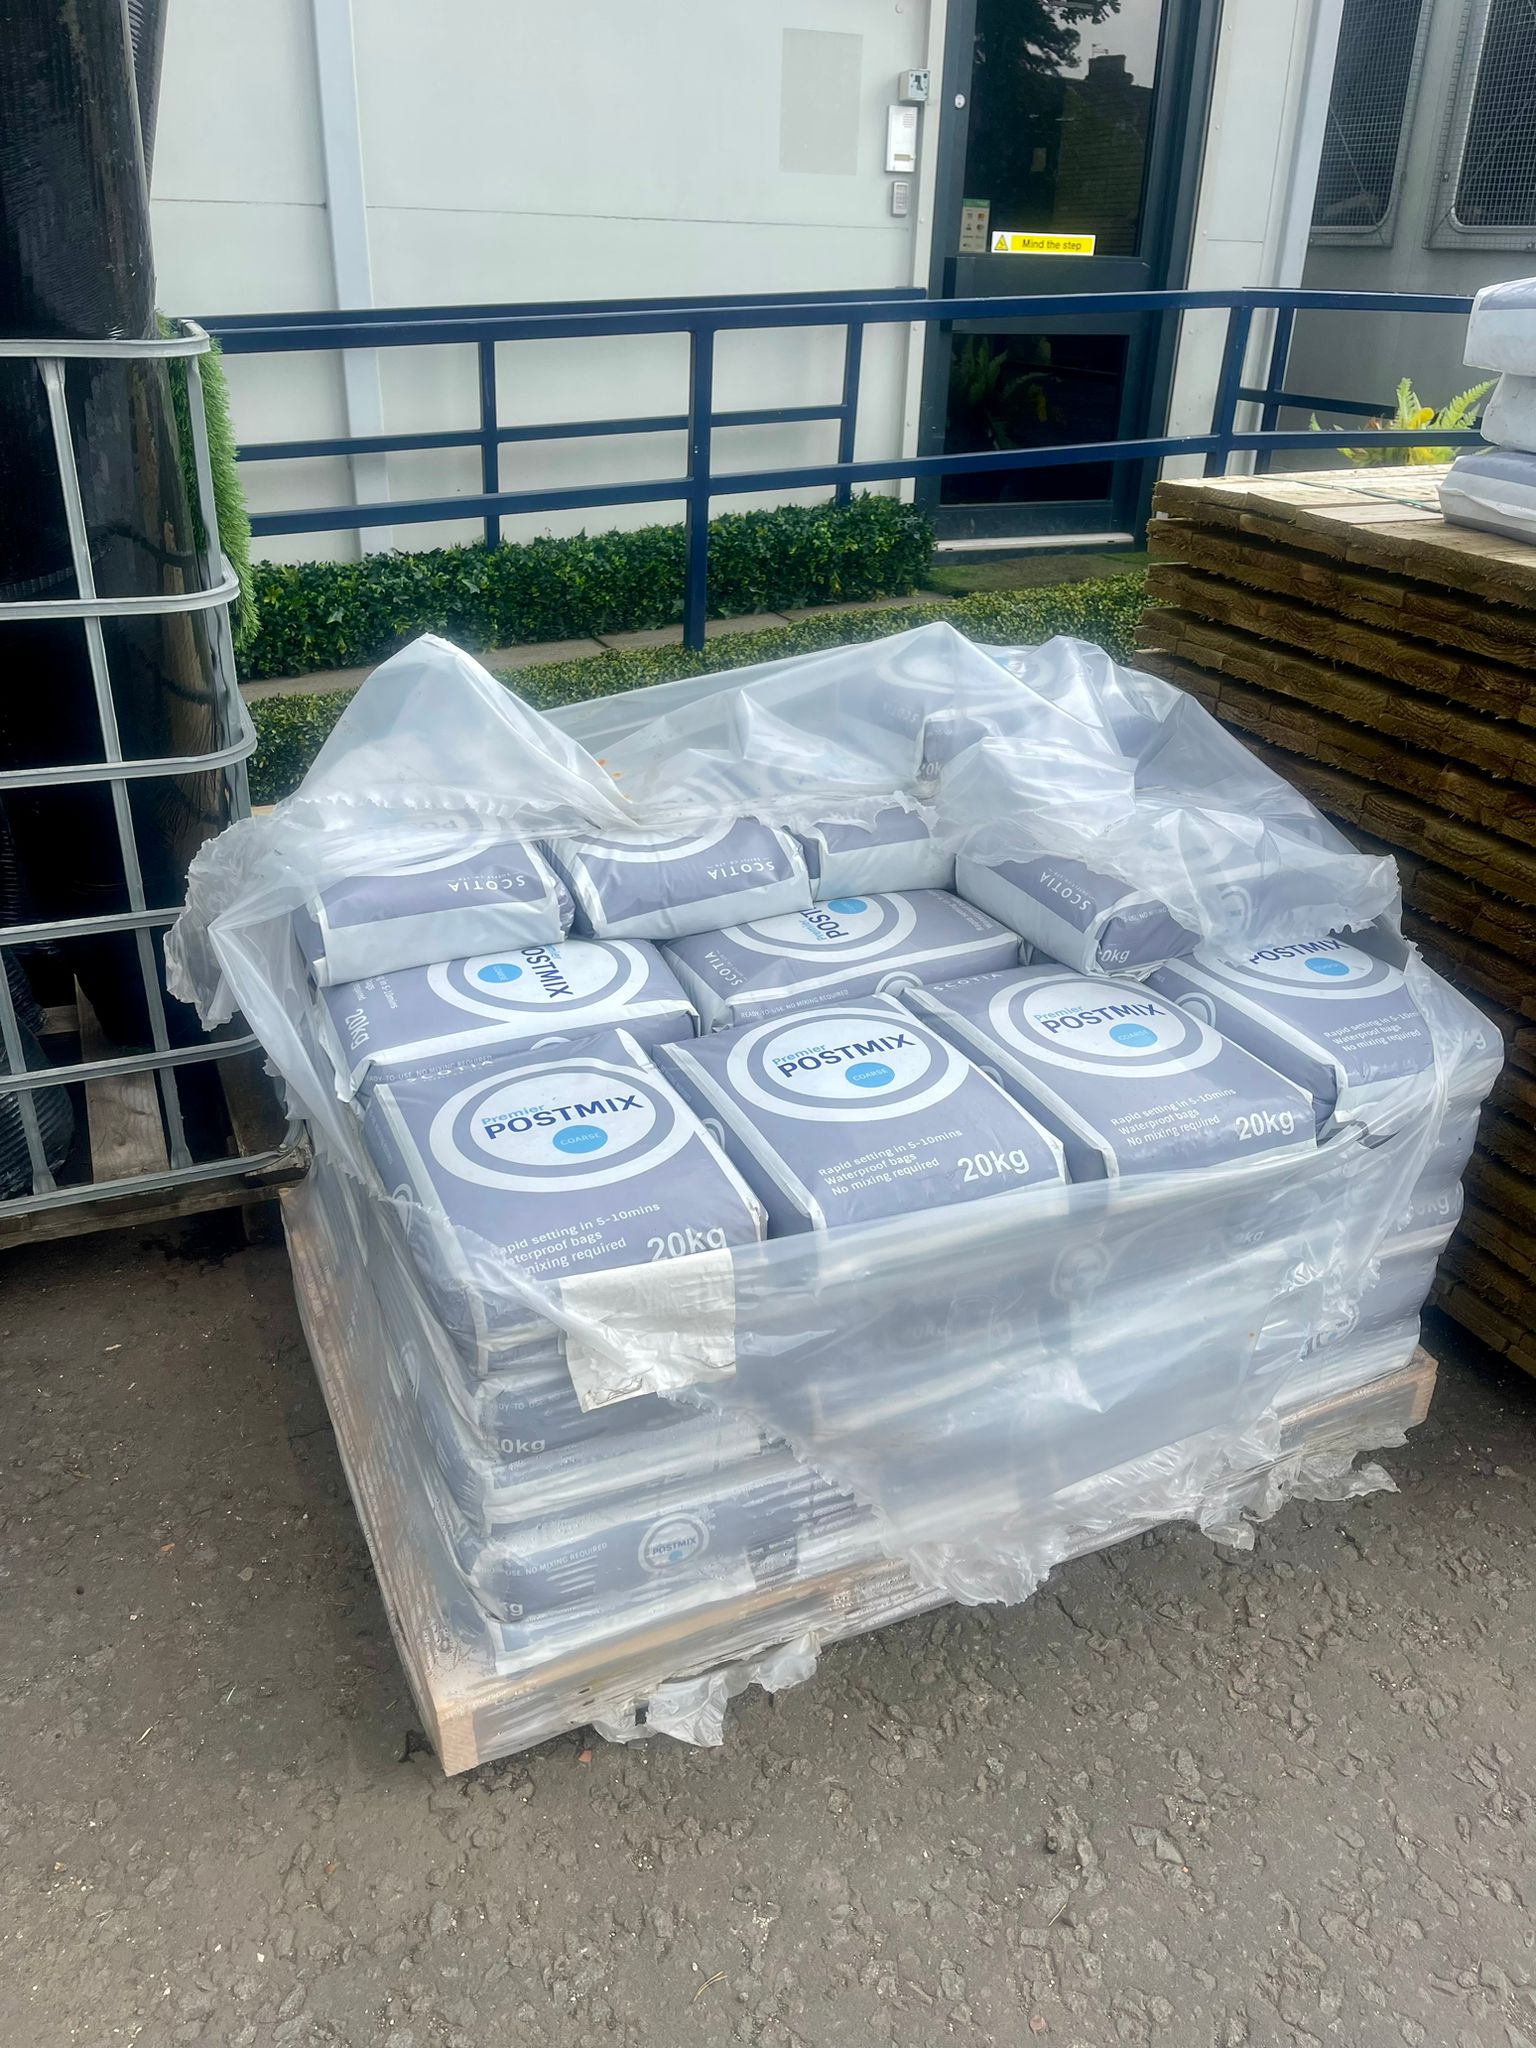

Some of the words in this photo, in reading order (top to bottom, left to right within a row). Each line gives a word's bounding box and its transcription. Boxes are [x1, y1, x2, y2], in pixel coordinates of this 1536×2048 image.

[1021, 239, 1045, 249] Mind
[1047, 239, 1060, 249] the
[1063, 240, 1082, 251] step
[448, 875, 526, 892] SCOTIA
[707, 861, 775, 880] SCOTIA
[1040, 871, 1091, 911] SCOTIA
[800, 907, 849, 940] POST
[704, 951, 744, 986] SCOTIA
[1099, 949, 1131, 963] 0kg
[520, 946, 574, 999] OSTMIX
[933, 972, 1003, 992] SCOTIA
[1034, 1005, 1085, 1022] Premier
[1040, 1003, 1166, 1034] POSTMIX
[1323, 1027, 1351, 1039] Rapid
[1350, 1019, 1383, 1032] setting
[1380, 1014, 1391, 1024] in
[345, 1008, 370, 1051] 20kg
[1332, 1029, 1383, 1045] Waterproof
[1381, 1024, 1402, 1034] bags
[1342, 1043, 1357, 1052] No
[1357, 1037, 1388, 1049] mixing
[1387, 1029, 1422, 1043] required
[772, 1044, 827, 1066] Premier
[777, 1033, 916, 1079] POSTMIX
[481, 1104, 545, 1125] Premier
[484, 1094, 644, 1140] POSTMIX
[1110, 1111, 1141, 1127] Rapid
[1143, 1102, 1177, 1118] setting
[1176, 1099, 1188, 1109] in
[1188, 1088, 1237, 1106] 5-10mins
[1118, 1115, 1175, 1136] Waterproof
[1175, 1109, 1200, 1121] bags
[560, 1132, 600, 1146] COARSE
[1127, 1137, 1142, 1148] No
[1143, 1124, 1180, 1144] mixing
[1180, 1114, 1221, 1133] required
[1235, 1110, 1295, 1141] 20kg
[818, 1160, 852, 1177] Rapid
[854, 1147, 895, 1166] setting
[894, 1144, 907, 1153] in
[907, 1128, 964, 1150] 5-10mins
[957, 1149, 1030, 1183] 20kg
[824, 1160, 888, 1185] Waterproof
[889, 1152, 918, 1166] bags
[831, 1185, 849, 1197] No
[851, 1170, 892, 1190] mixing
[892, 1157, 940, 1178] required
[531, 1224, 577, 1246] setting
[579, 1220, 594, 1232] in
[596, 1203, 661, 1227] 5-10mins
[570, 1231, 603, 1249] bags
[571, 1237, 627, 1262] required
[647, 1225, 728, 1263] 20kg
[498, 1438, 546, 1455] 0kg
[525, 1566, 537, 1576] NO
[539, 1556, 569, 1573] MIXING
[569, 1542, 608, 1562] REQUIRED
[652, 1536, 697, 1556] POSTMIX
